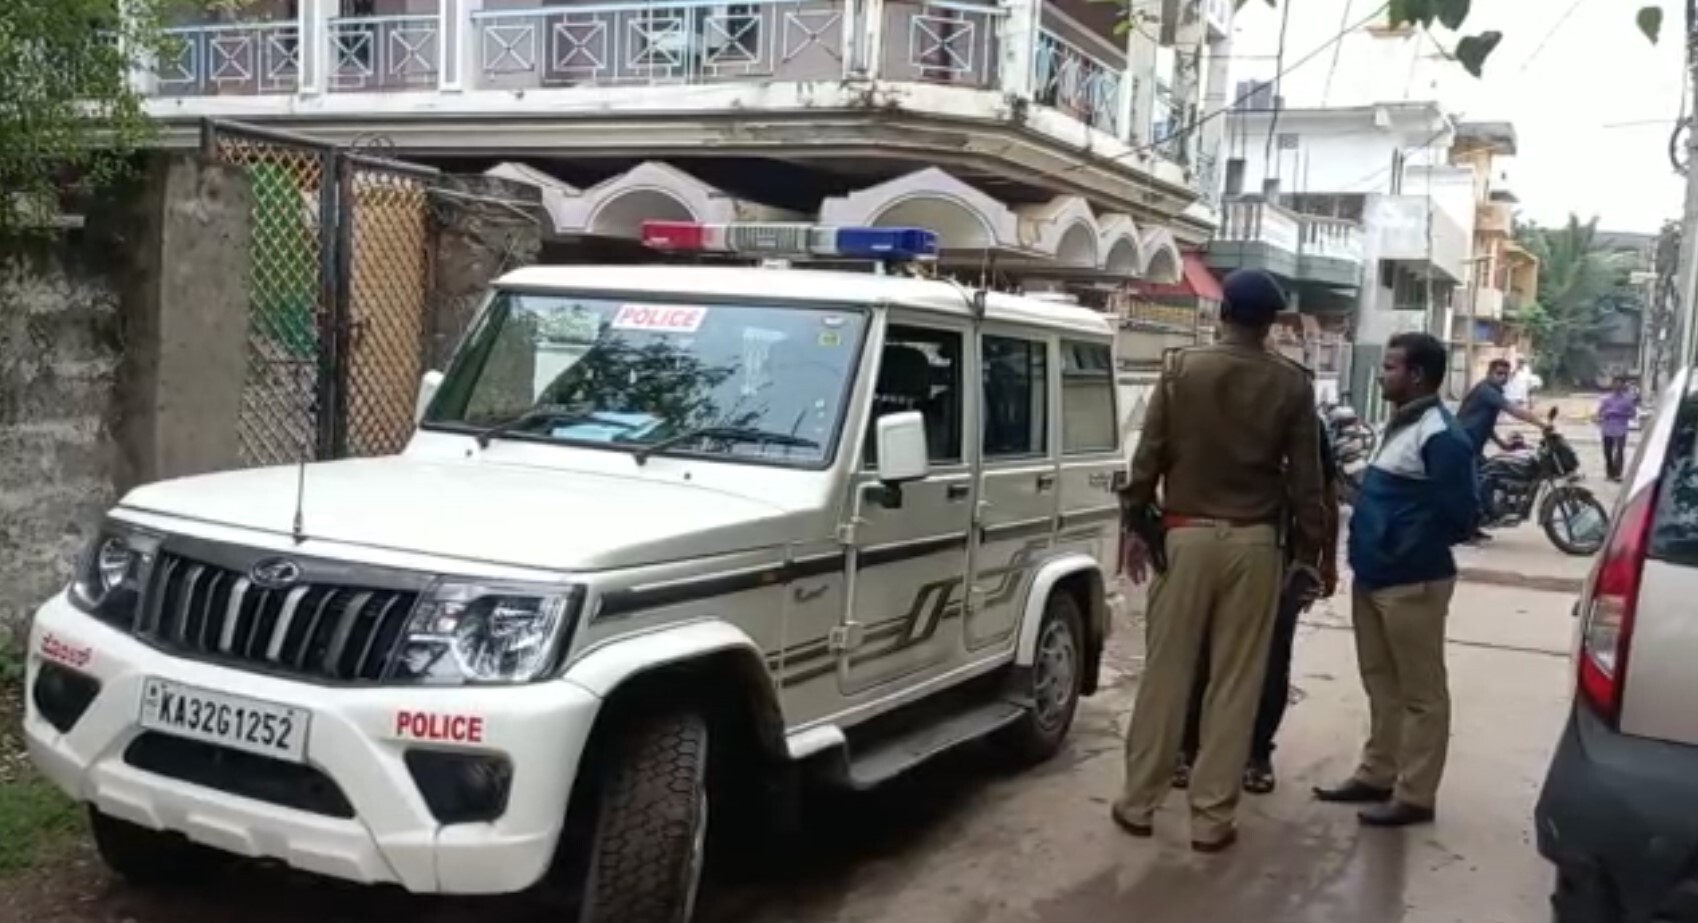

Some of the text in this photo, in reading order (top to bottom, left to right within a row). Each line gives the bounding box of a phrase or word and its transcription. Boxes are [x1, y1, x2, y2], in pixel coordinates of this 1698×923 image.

[617, 306, 700, 328] POLICE
[158, 690, 293, 750] KA32G1252
[396, 710, 484, 742] POLICE
